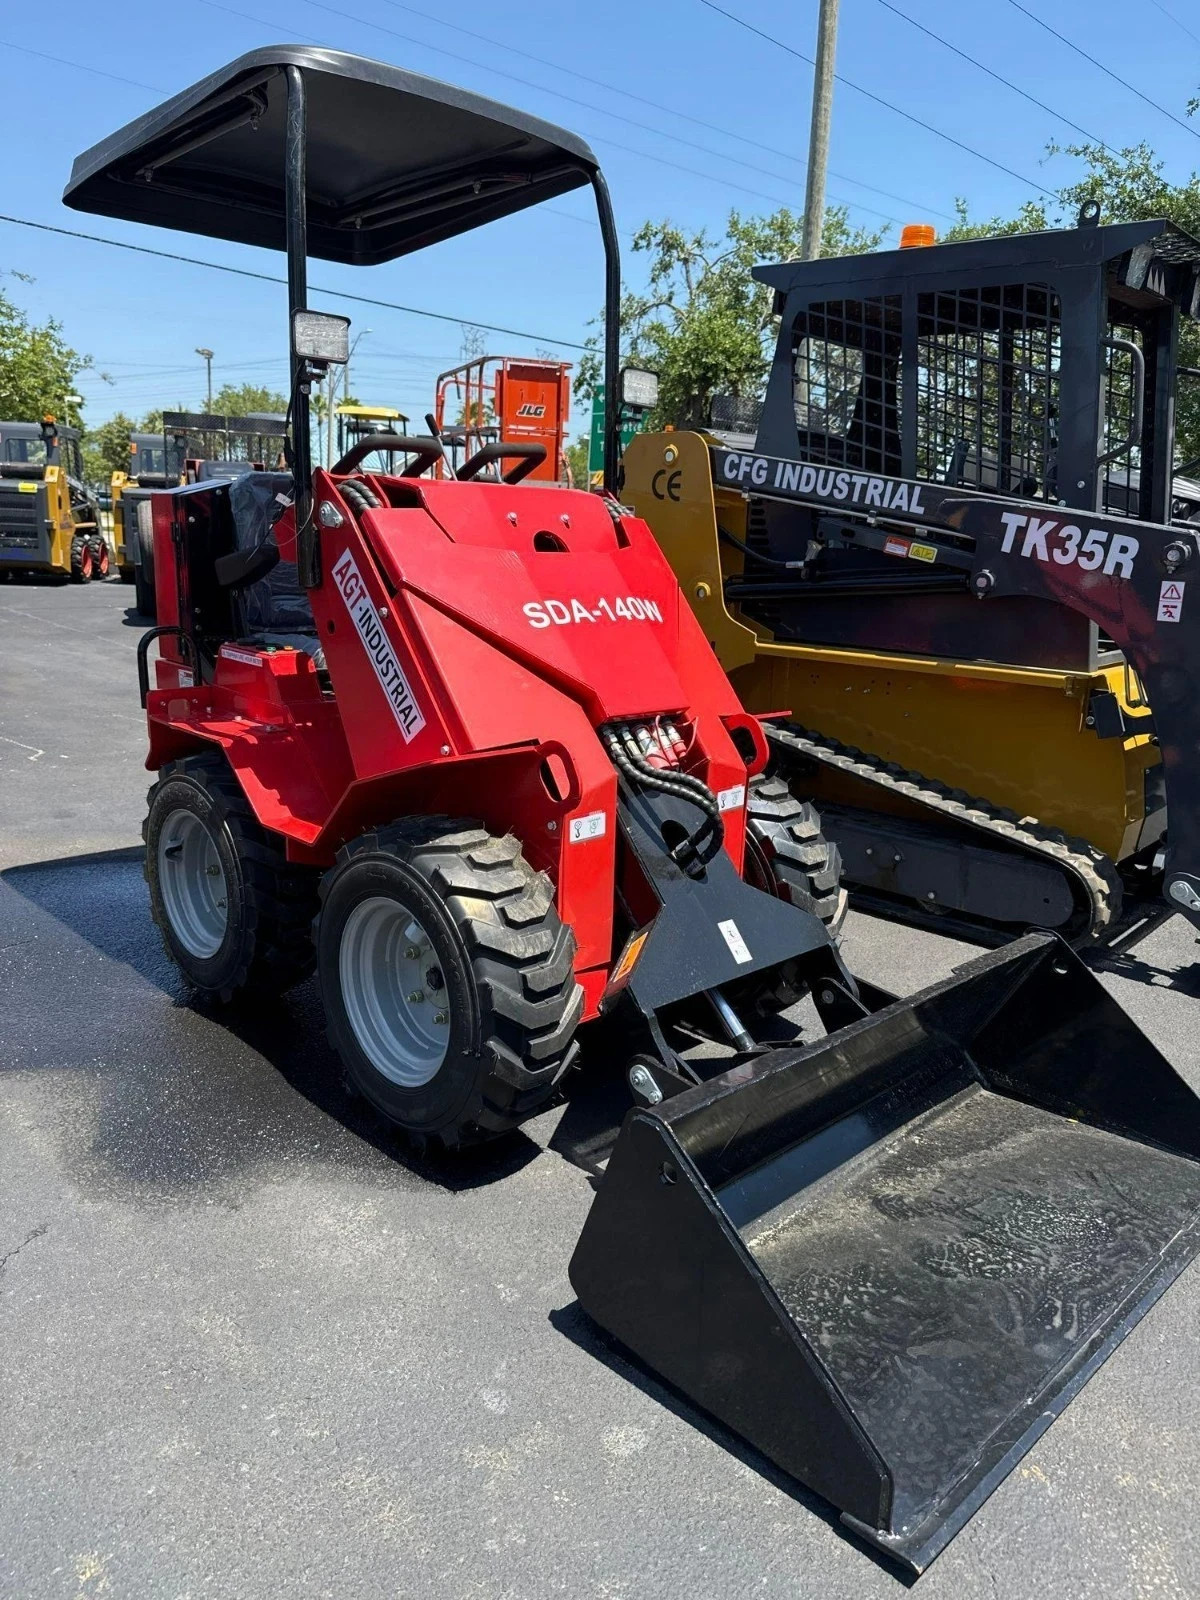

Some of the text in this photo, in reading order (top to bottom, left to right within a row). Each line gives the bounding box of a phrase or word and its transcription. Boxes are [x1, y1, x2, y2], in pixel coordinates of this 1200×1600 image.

[517, 404, 546, 418] JLG
[652, 469, 682, 501] CE
[723, 453, 926, 515] CFG INDUSTRIAL
[1000, 511, 1140, 580] TK35R
[522, 597, 664, 629] SDA-140W
